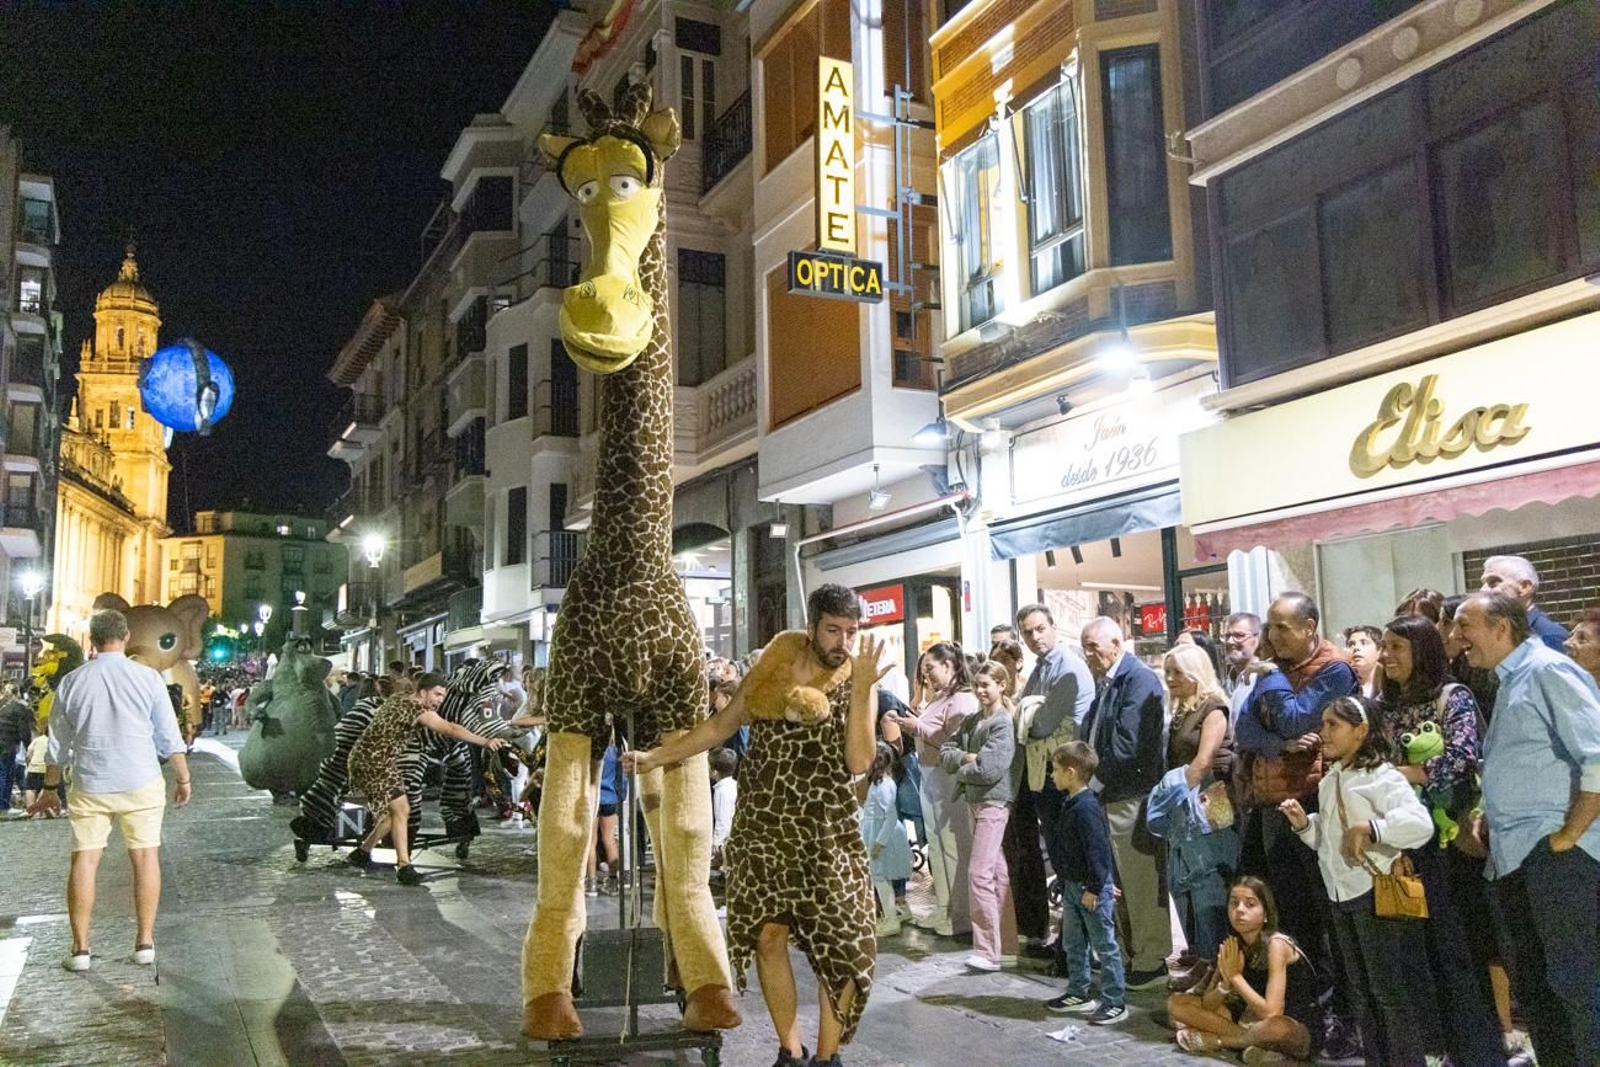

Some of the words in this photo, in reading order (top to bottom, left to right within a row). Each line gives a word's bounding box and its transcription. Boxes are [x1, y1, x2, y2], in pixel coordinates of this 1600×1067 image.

[824, 67, 850, 243] AMATE
[797, 259, 881, 294] OPTICA
[1062, 459, 1098, 488] desde
[1105, 436, 1158, 477] 1936
[1349, 374, 1532, 478] Elisa
